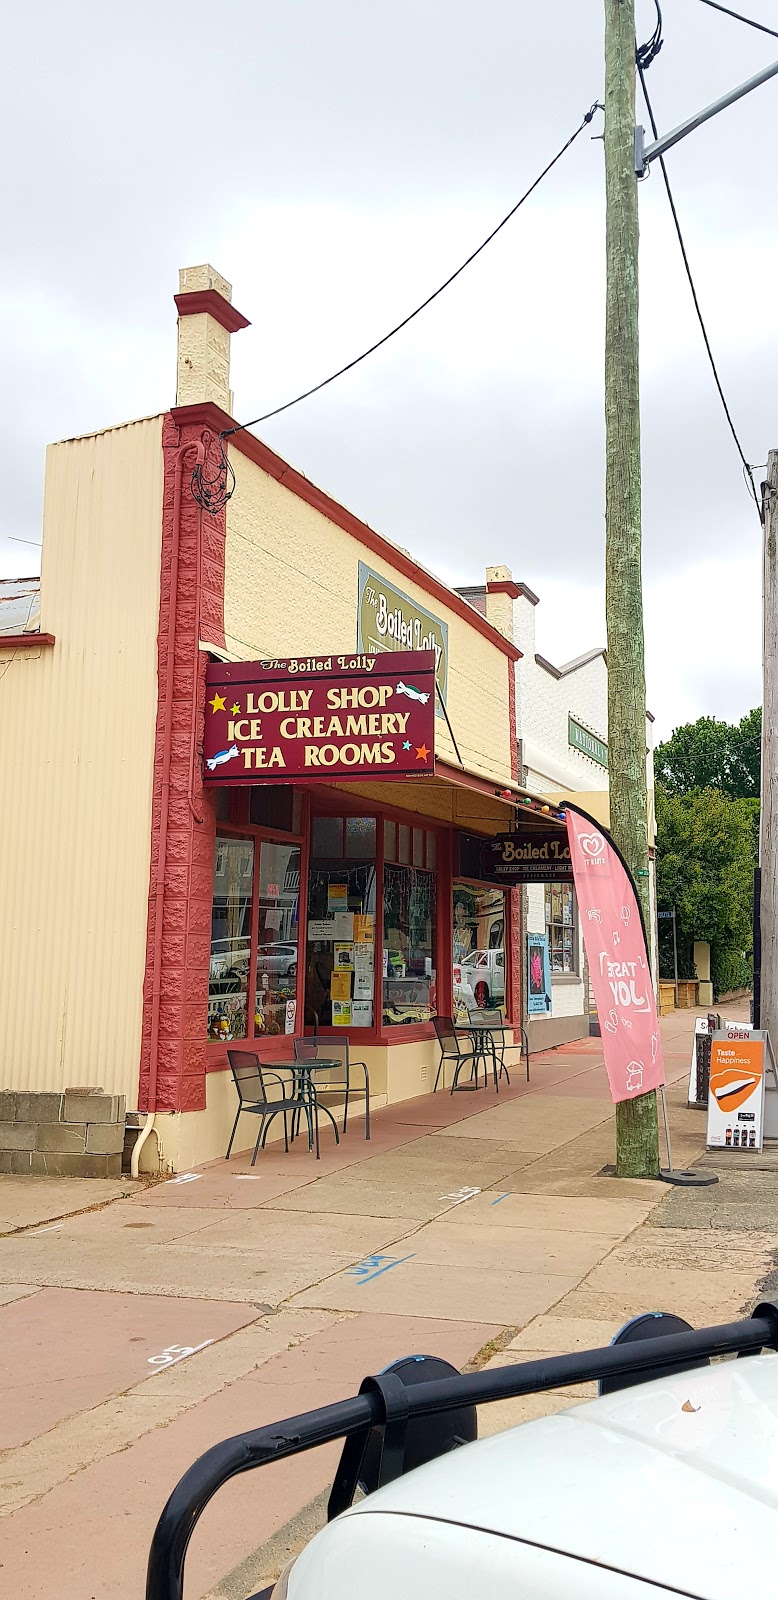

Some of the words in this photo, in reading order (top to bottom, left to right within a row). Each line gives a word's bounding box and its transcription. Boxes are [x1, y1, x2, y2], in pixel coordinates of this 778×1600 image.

[365, 586, 378, 608] The
[375, 593, 414, 650] Boiled
[260, 660, 286, 670] The
[288, 657, 332, 674] Boiled
[337, 655, 376, 671] Lolly
[246, 690, 314, 714] LOLLY
[326, 685, 393, 710] SHOP
[227, 719, 263, 741] ICE
[279, 712, 410, 739] CREAMERY
[241, 746, 286, 769] TEA
[304, 742, 396, 766] ROOMS
[502, 841, 550, 861] Boiled
[550, 841, 571, 860] Lo
